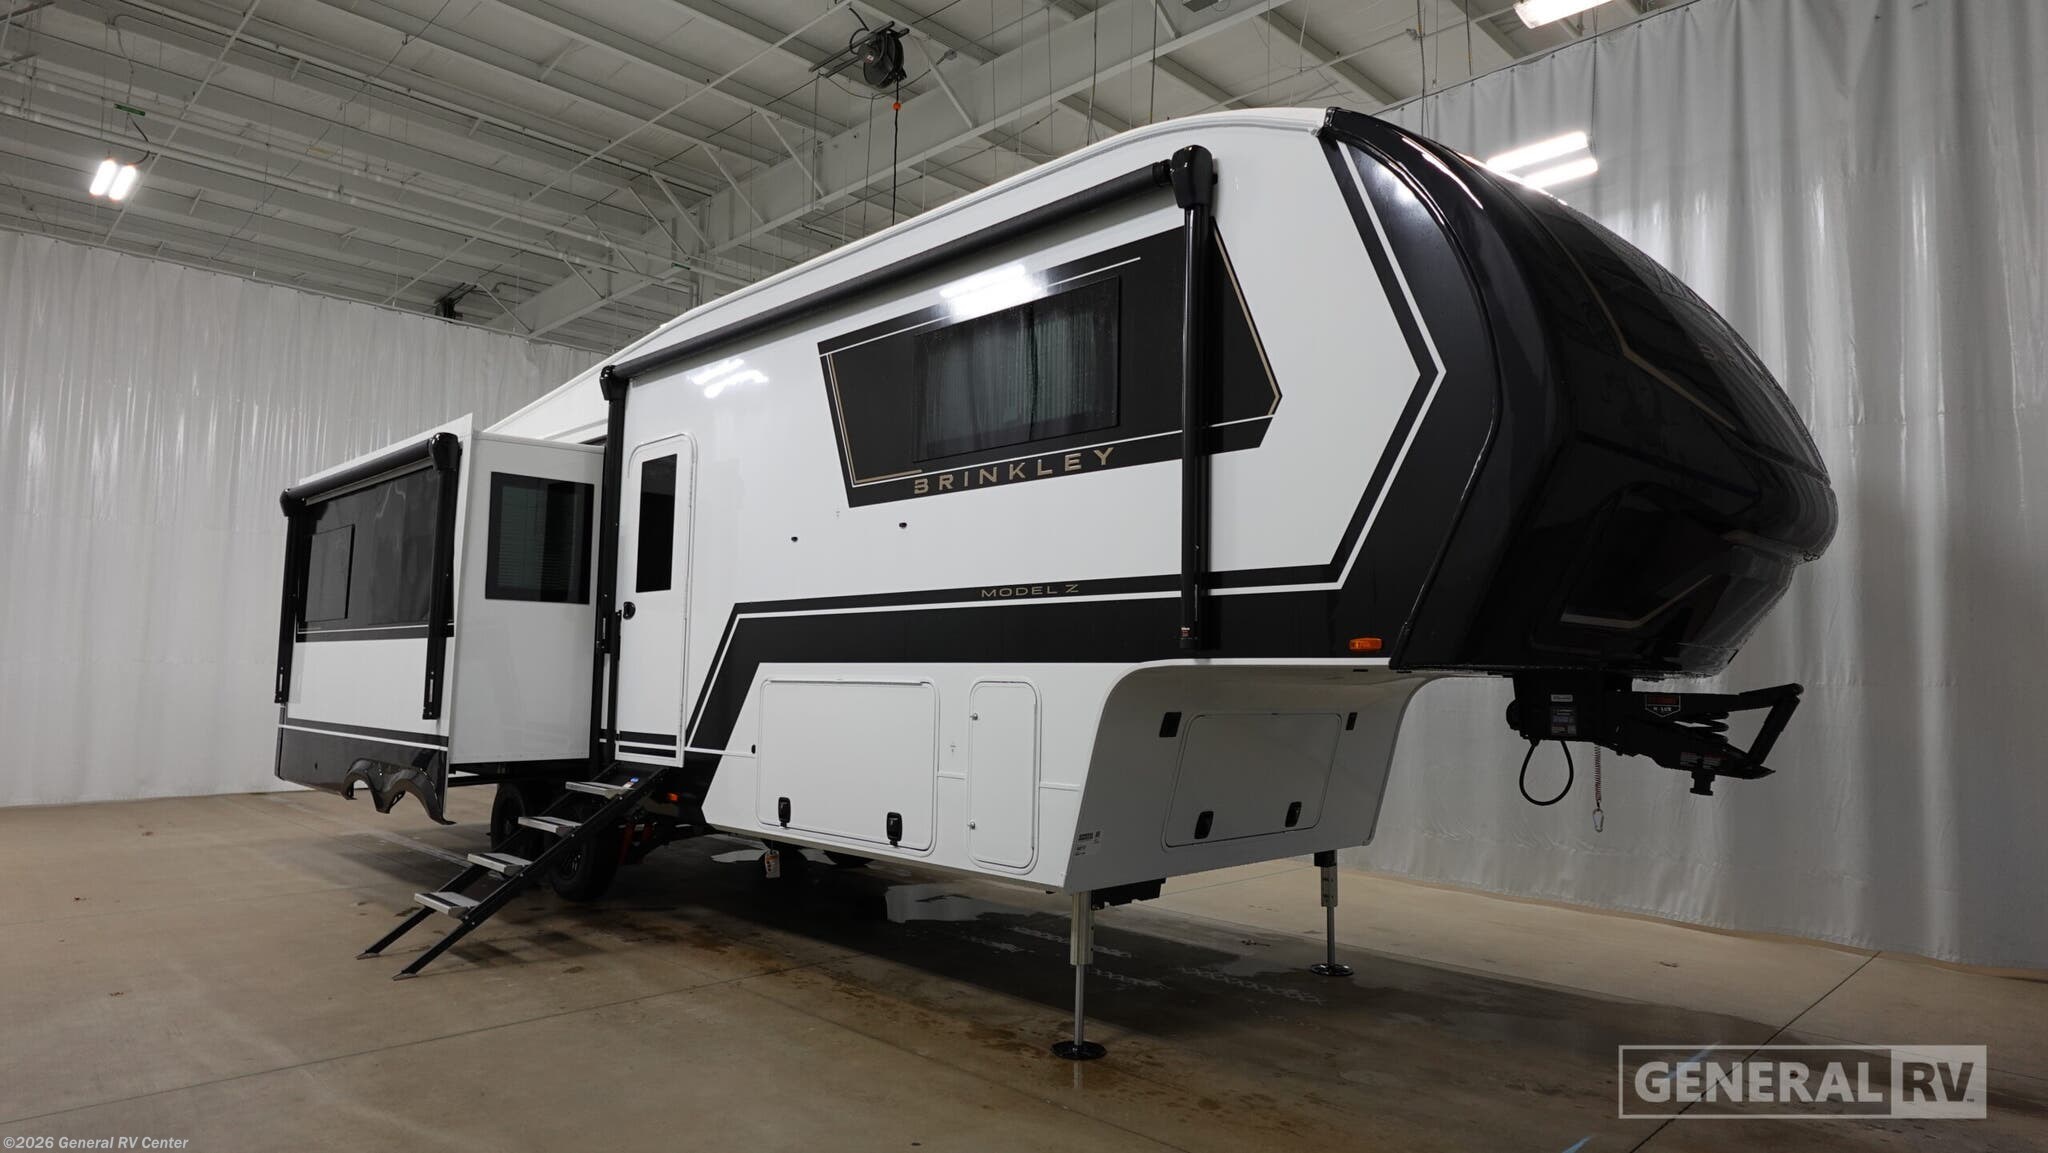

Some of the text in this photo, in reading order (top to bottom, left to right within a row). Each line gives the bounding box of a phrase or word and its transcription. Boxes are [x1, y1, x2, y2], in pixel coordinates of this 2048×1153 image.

[914, 447, 1114, 494] BRINKLEY
[981, 584, 1079, 598] MODEL Z
